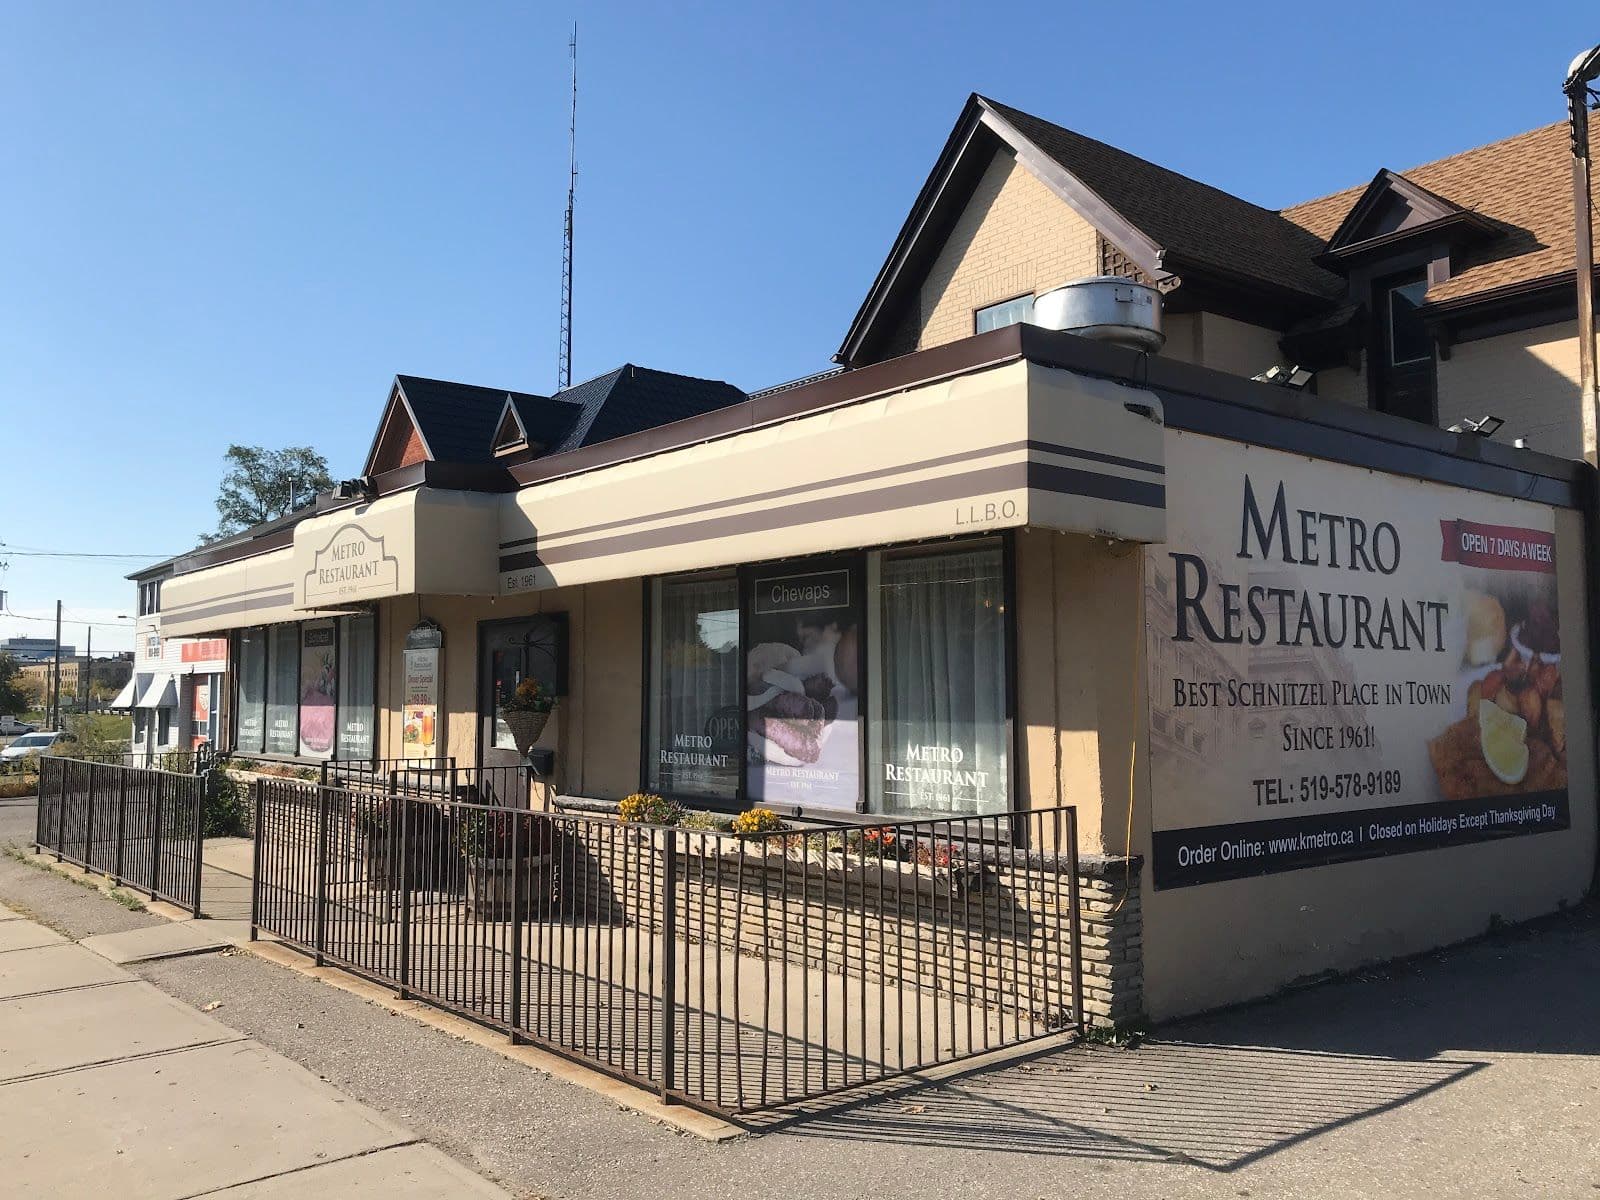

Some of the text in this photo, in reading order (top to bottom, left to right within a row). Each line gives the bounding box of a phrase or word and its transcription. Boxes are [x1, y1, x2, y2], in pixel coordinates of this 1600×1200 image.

[955, 500, 1020, 525] L.L.B.O.
[1237, 473, 1401, 575] METRO
[331, 541, 365, 561] METRO
[1461, 532, 1552, 563] OPEN 7 DAYS A WEEK
[319, 560, 379, 585] RESTAURANT
[521, 574, 536, 587] 1961
[771, 583, 830, 603] Chevaps
[1169, 552, 1448, 651] RESTAURANT
[1173, 678, 1452, 707] BEST SCHNITZEL PLACE IN TOWN
[340, 733, 370, 744] RESTAURANT
[674, 733, 712, 748] METRO
[1282, 723, 1375, 751] SINCE 1961!
[660, 750, 729, 767] RESTAURANT
[906, 743, 964, 763] METRO
[765, 766, 840, 781] METRO RESTAURANT
[885, 763, 989, 788] RESTAURANT
[1253, 770, 1401, 806] TEL: 519-578-9189
[1178, 803, 1556, 867] Order Online: www.kmetro.ca Closed on Holidays Except Thanksgiving Day
